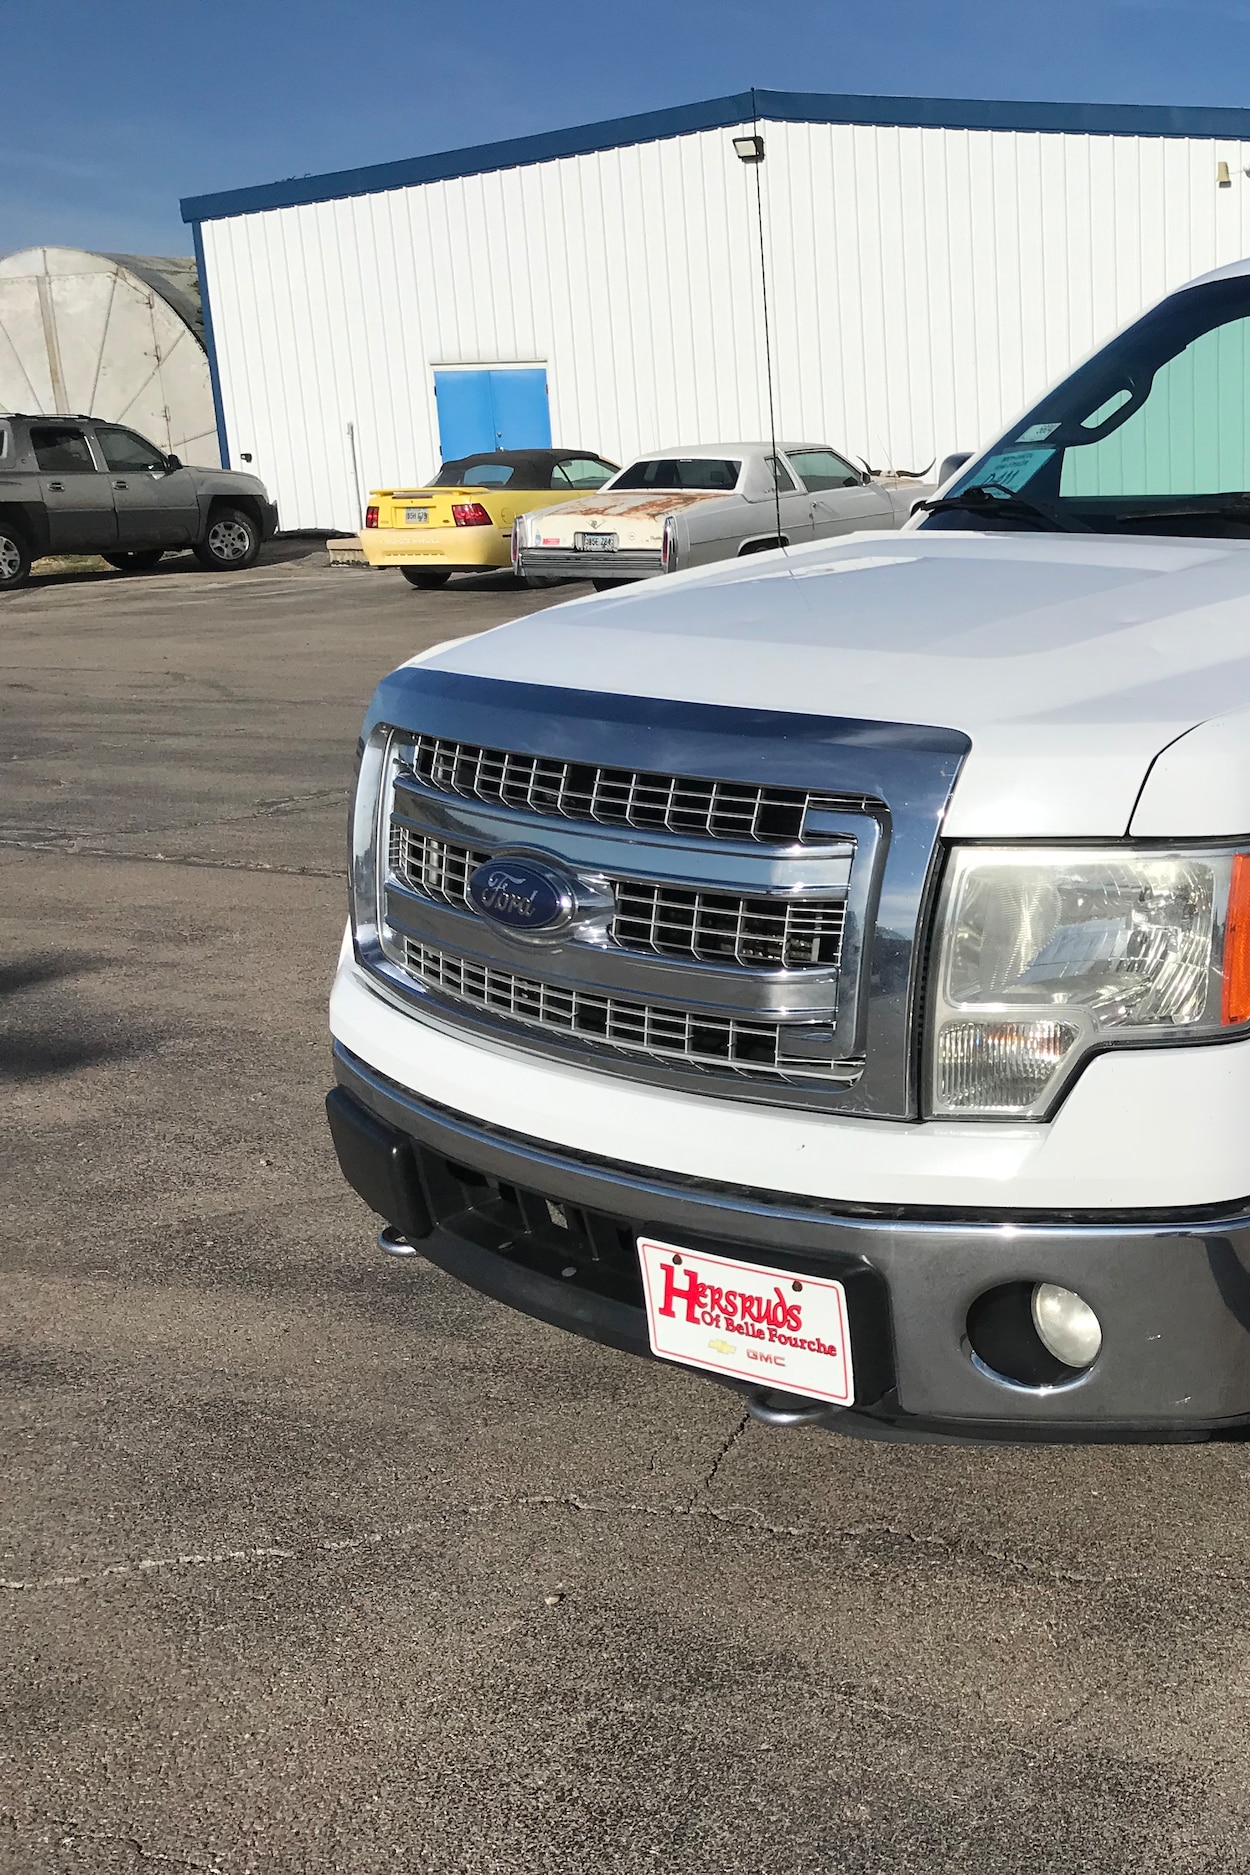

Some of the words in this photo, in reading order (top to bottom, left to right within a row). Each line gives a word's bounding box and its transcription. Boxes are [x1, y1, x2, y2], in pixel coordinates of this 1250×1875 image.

[481, 870, 539, 918] Ford
[701, 1310, 721, 1329] Of
[725, 1317, 766, 1341] Belle
[767, 1326, 838, 1358] Fourche
[746, 1348, 787, 1367] GMC
